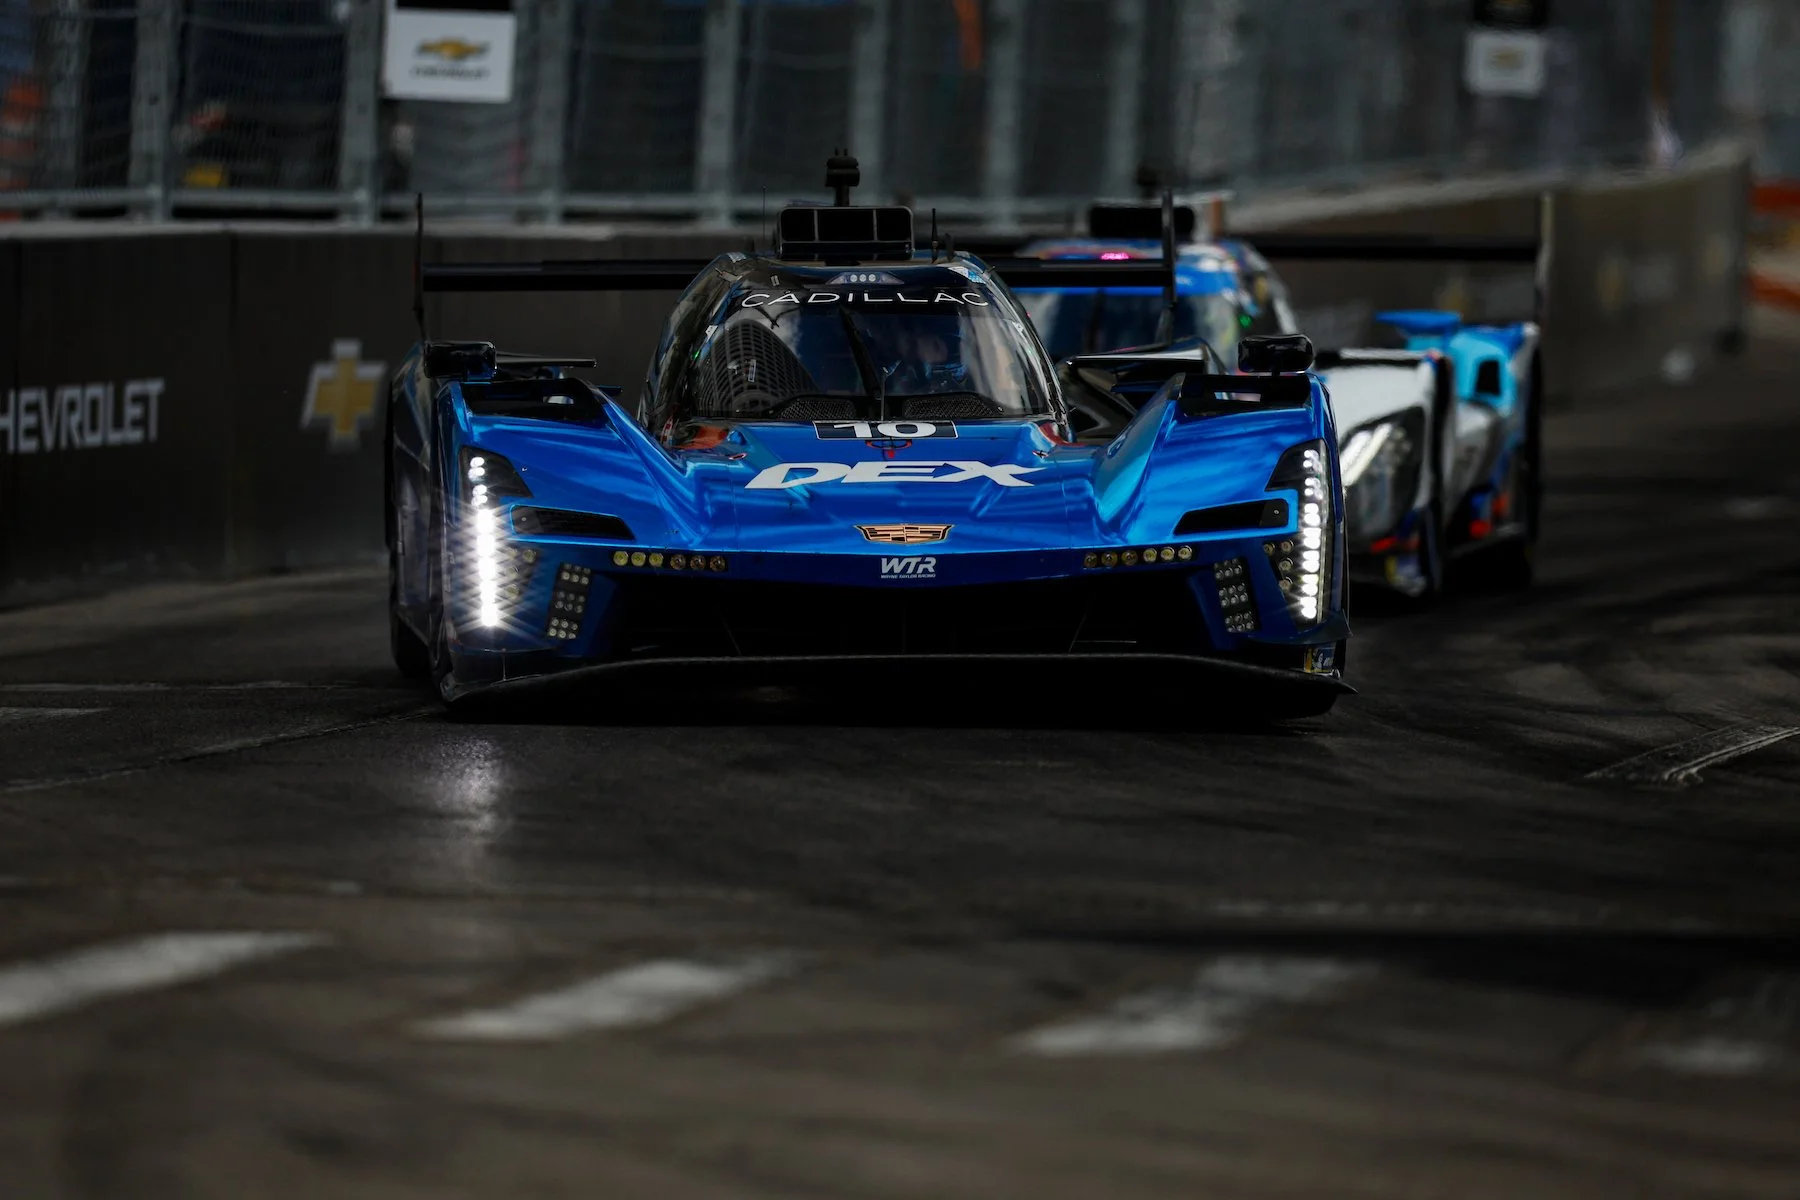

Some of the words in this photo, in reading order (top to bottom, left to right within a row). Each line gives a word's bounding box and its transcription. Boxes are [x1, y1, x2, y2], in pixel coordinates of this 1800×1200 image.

[741, 292, 989, 308] CADILLAC
[833, 422, 937, 438] 10
[744, 460, 1047, 489] DEX
[881, 556, 937, 574] WTR
